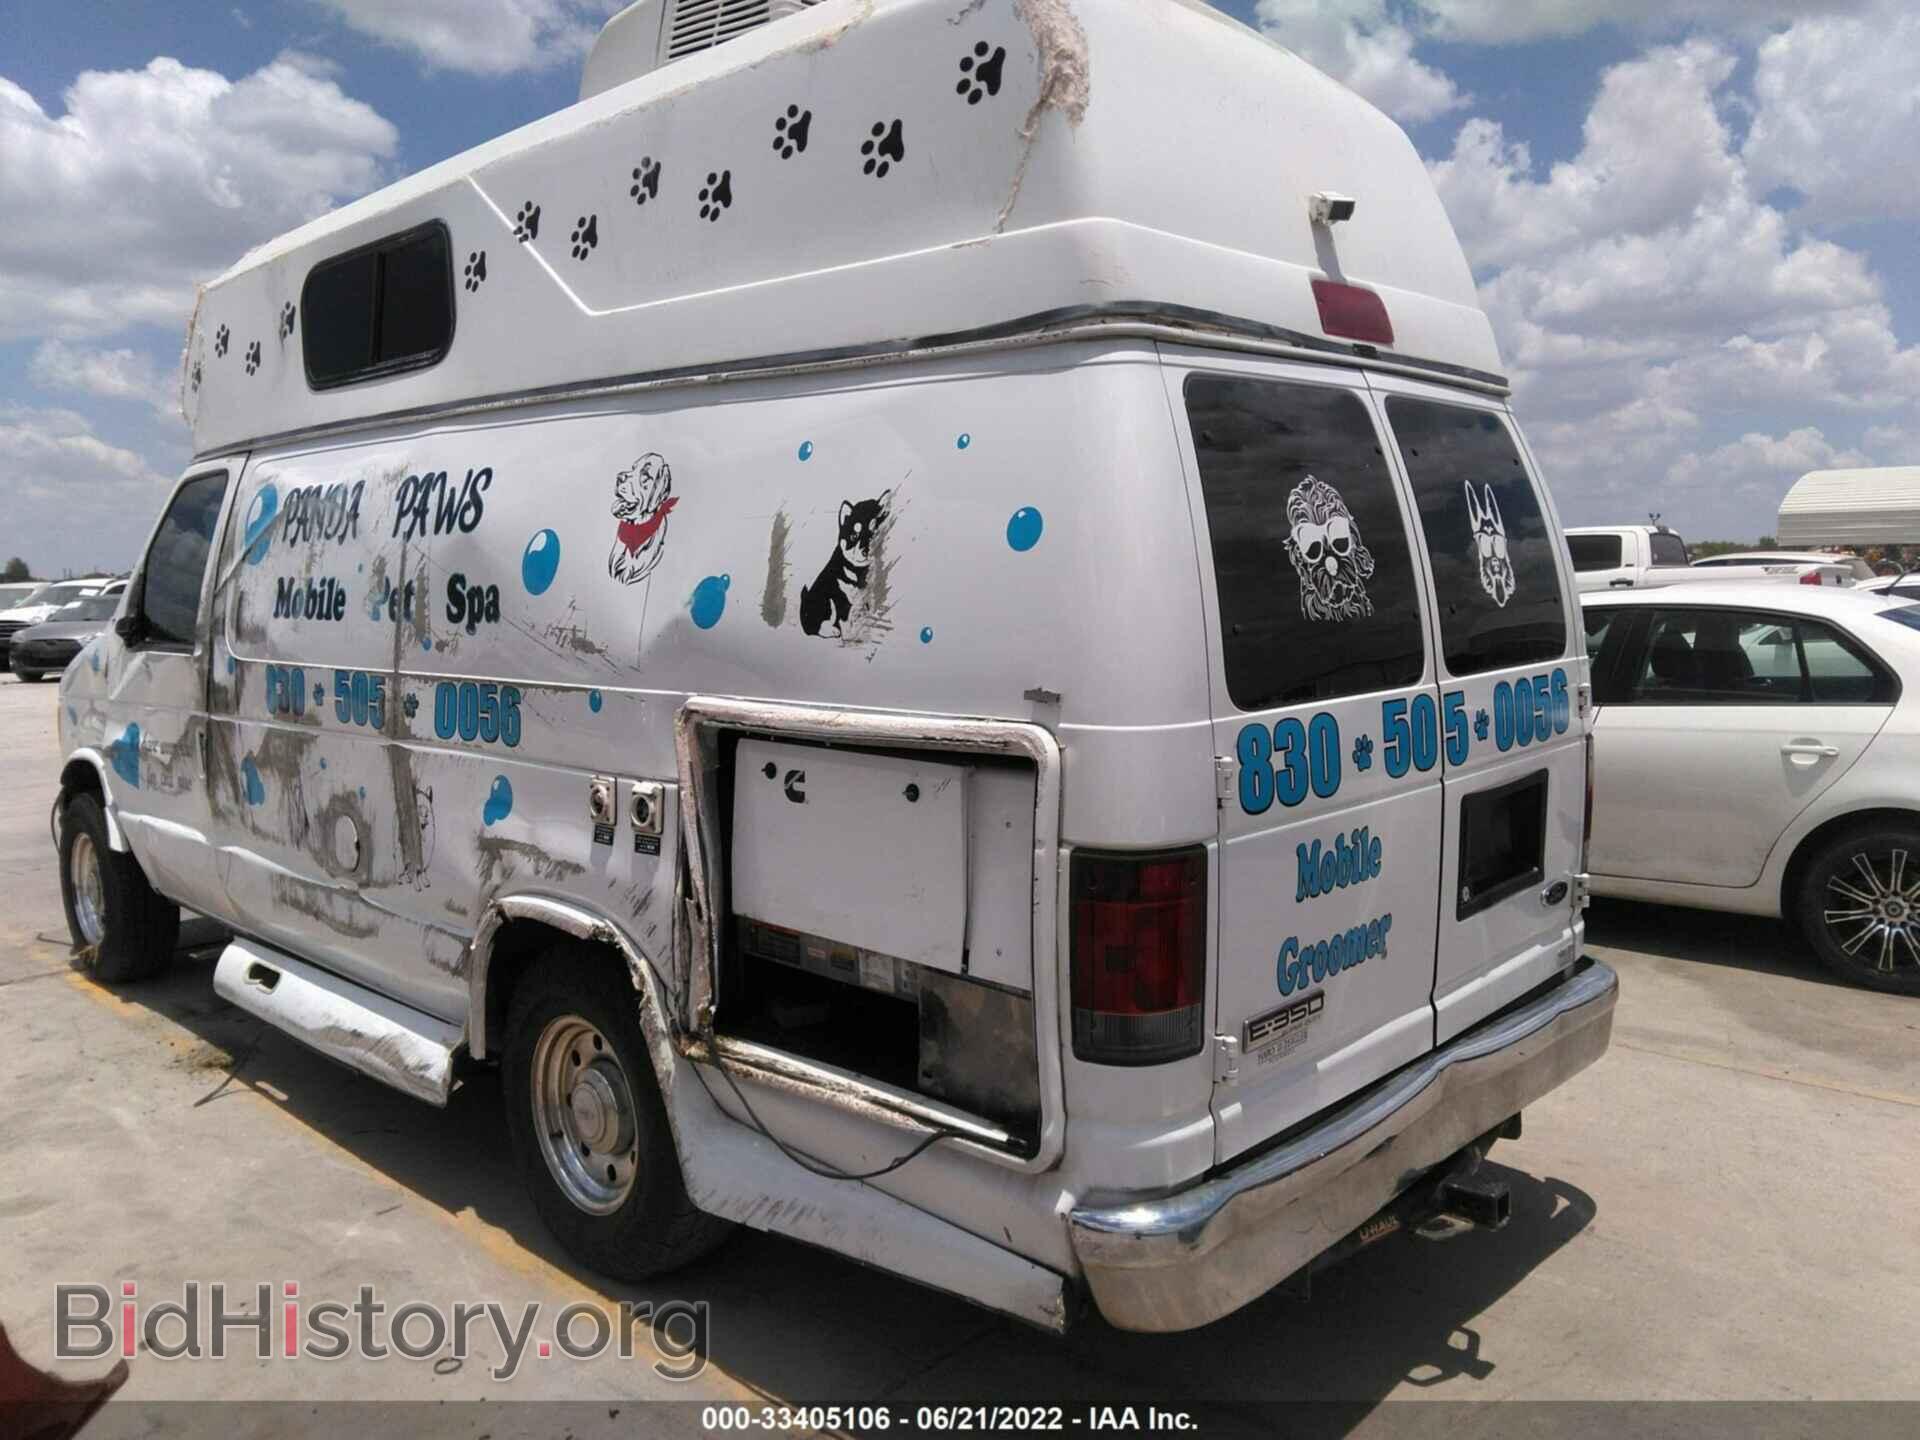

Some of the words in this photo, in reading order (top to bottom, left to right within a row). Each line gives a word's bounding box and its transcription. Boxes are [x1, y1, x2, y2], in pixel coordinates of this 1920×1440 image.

[392, 467, 493, 541] PAWS
[273, 577, 346, 621] Mobile
[446, 573, 500, 635] Spa
[334, 671, 386, 730] 505
[434, 682, 521, 748] 0056
[1237, 712, 1342, 815] 830
[1382, 692, 1469, 778] 505
[1493, 667, 1569, 753] 0056
[1296, 826, 1382, 903] Mobile
[1277, 912, 1392, 997] Groomer
